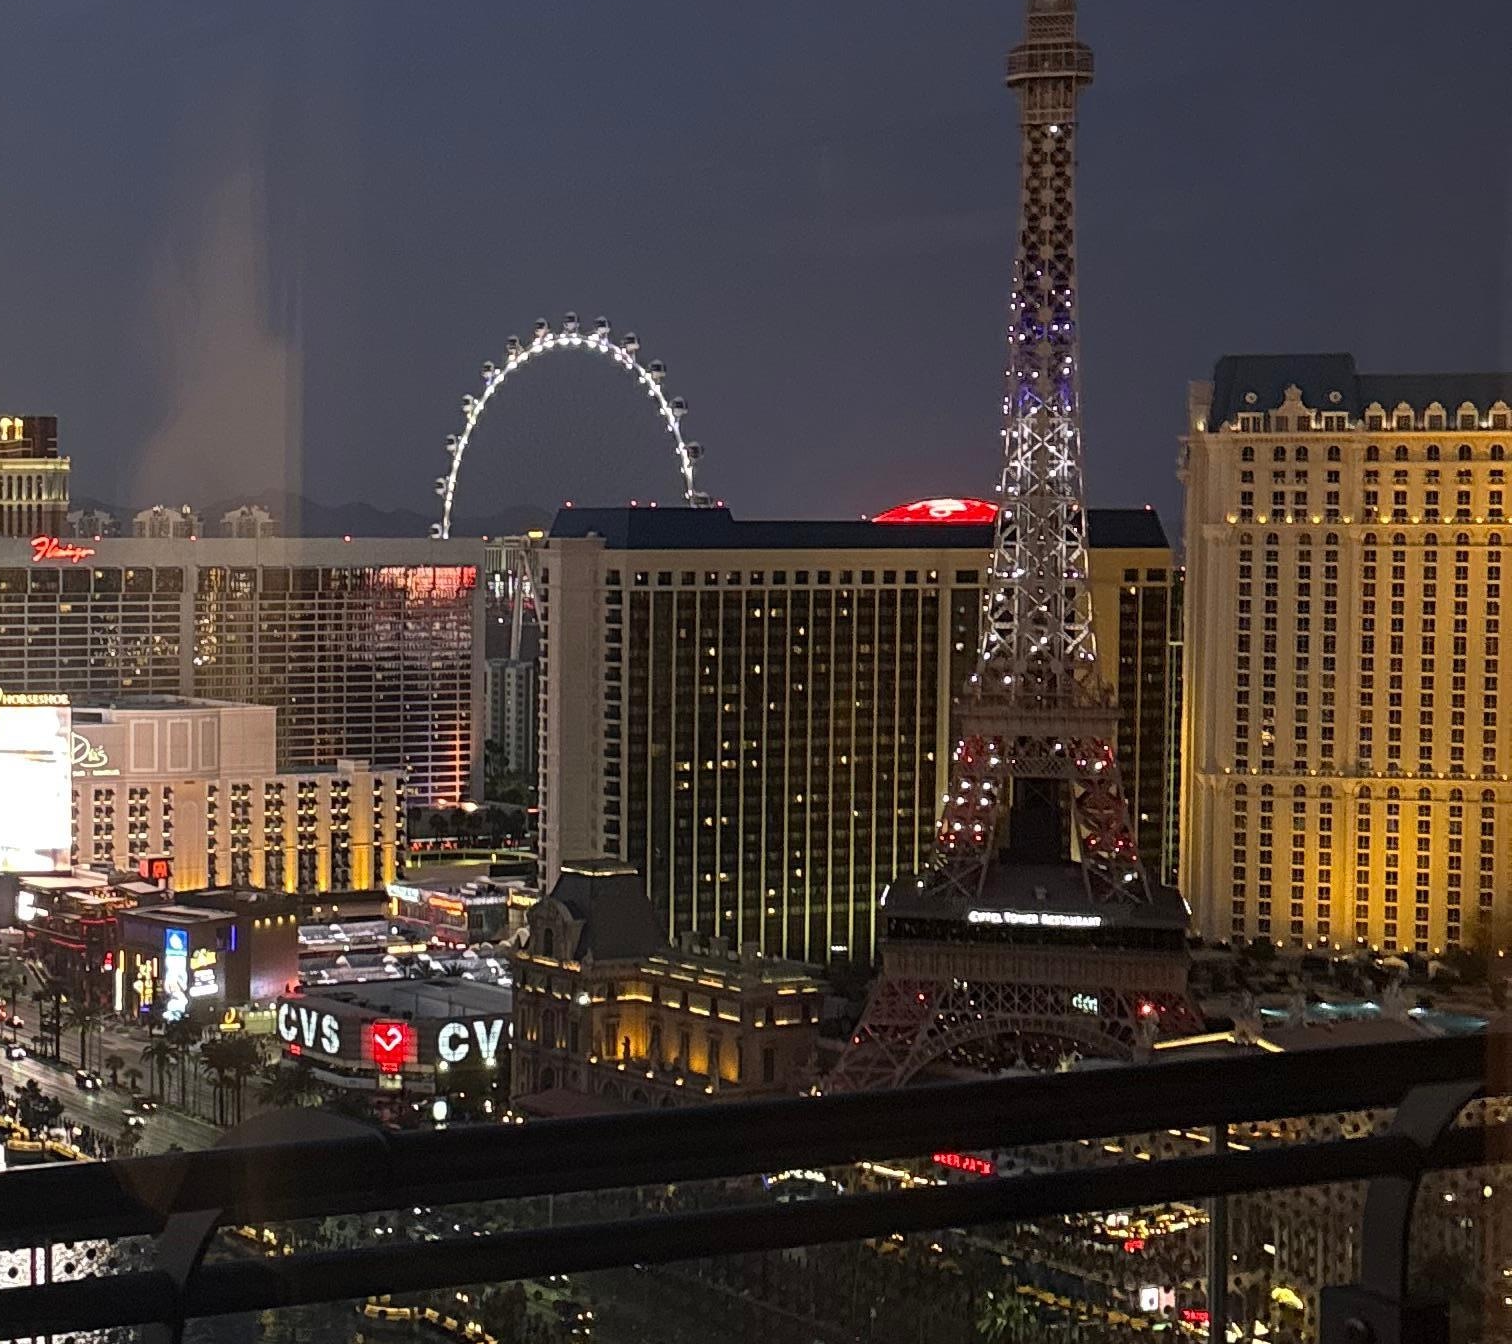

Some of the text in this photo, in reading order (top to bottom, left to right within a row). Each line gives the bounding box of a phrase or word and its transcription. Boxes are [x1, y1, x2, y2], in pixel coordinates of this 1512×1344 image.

[2, 693, 70, 705] HORSESHOE
[278, 1003, 340, 1054] CVS
[438, 1019, 514, 1062] CV
